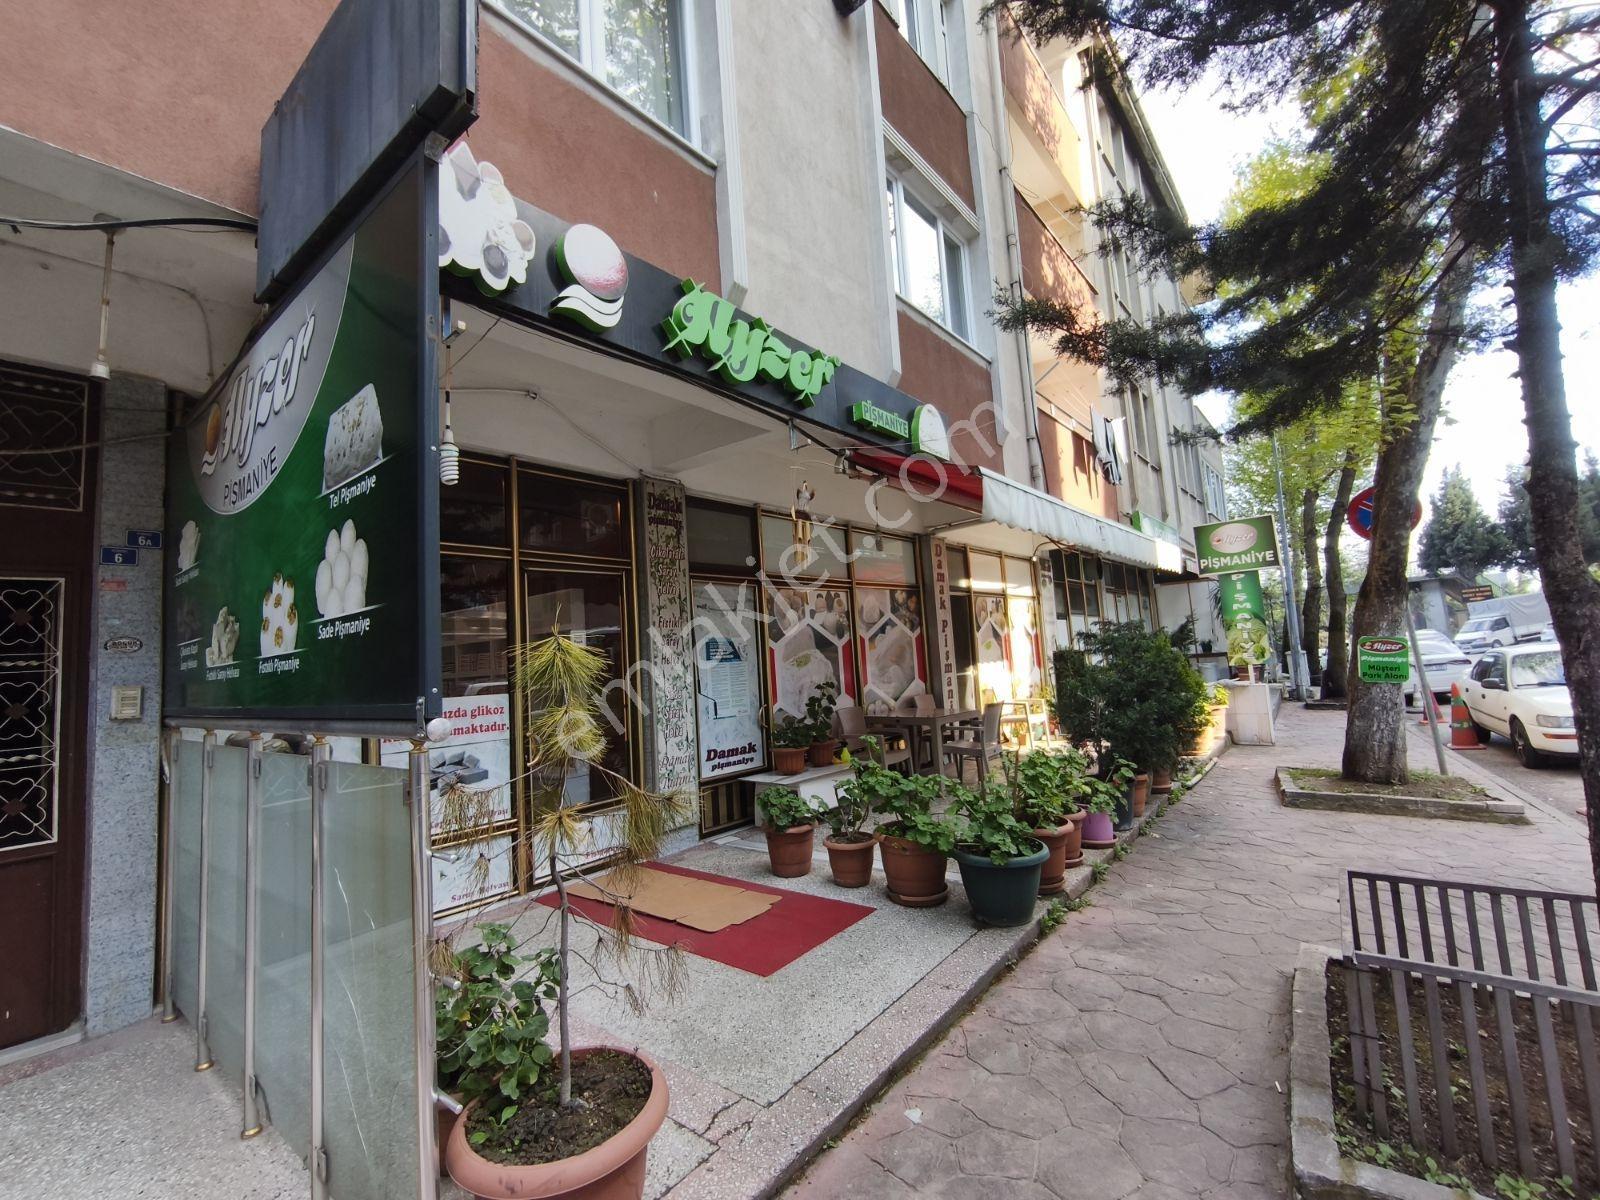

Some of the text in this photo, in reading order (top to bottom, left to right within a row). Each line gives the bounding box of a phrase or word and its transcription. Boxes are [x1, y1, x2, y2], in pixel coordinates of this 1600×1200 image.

[860, 399, 910, 439] PİŞMANİYE
[222, 445, 279, 506] PİŞMANİYE
[329, 474, 377, 510] Tel Pişmaniye
[114, 553, 123, 563] 6
[1200, 550, 1275, 569] PİŞMANİYE
[933, 543, 947, 611] Damak
[318, 617, 370, 640] Sade Pişmaniye
[1362, 671, 1382, 679] Park
[470, 704, 505, 720] glikoz
[705, 741, 757, 762] Damak
